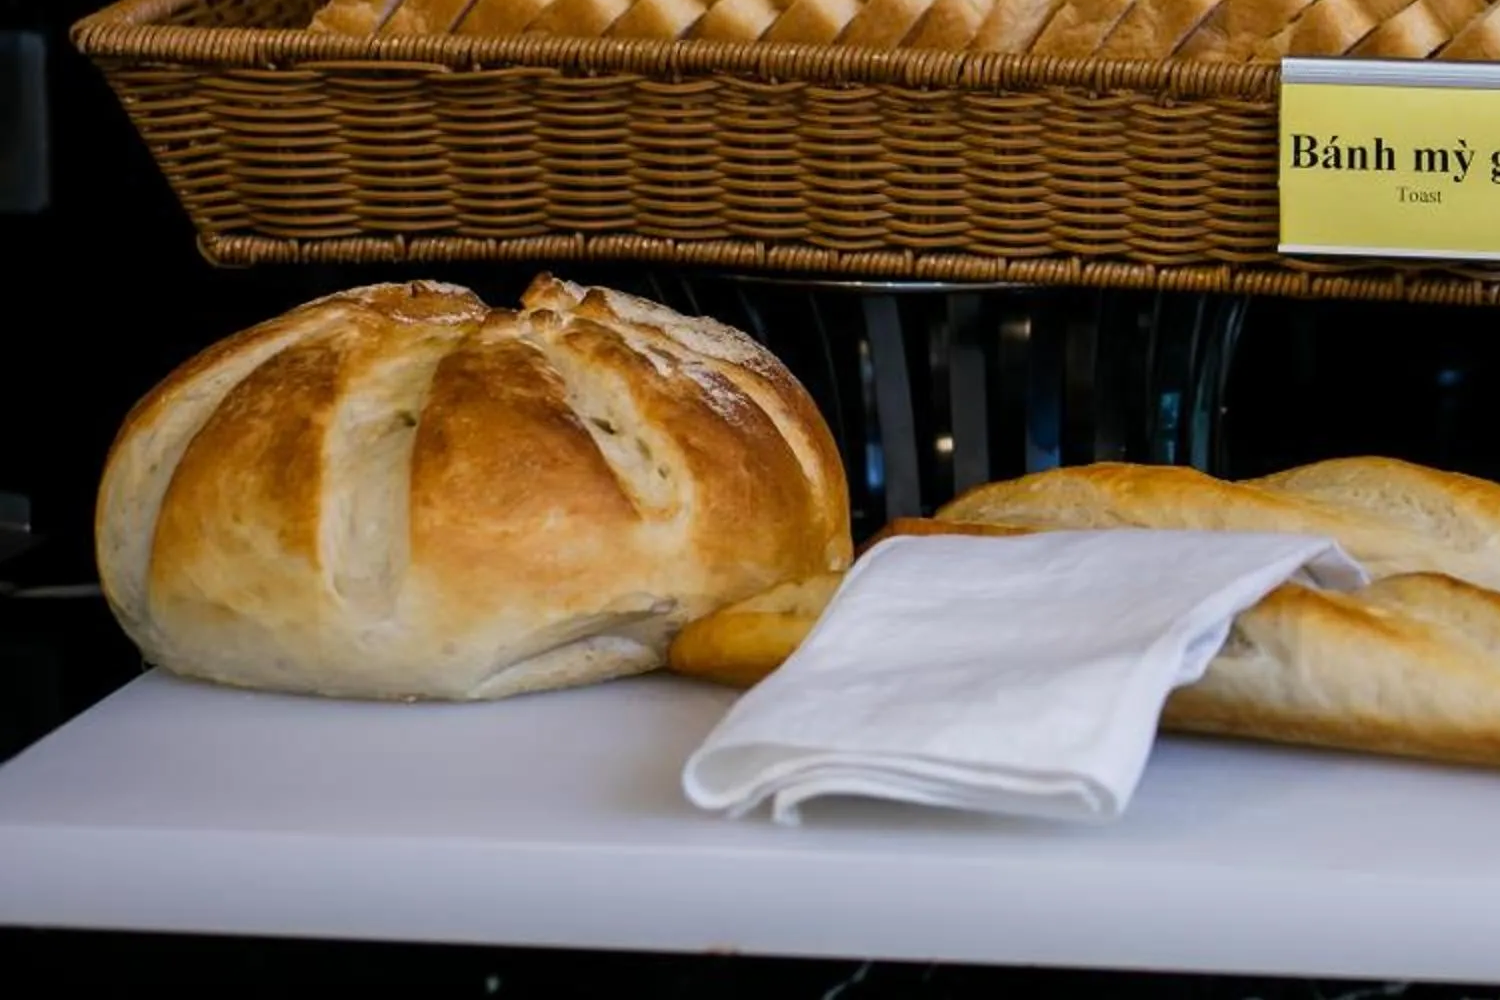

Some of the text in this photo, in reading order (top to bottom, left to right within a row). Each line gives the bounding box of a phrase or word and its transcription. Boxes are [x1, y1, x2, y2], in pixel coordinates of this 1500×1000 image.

[1290, 134, 1396, 172] Bánh
[1413, 139, 1475, 183] mỳ
[1396, 186, 1442, 204] Toast
